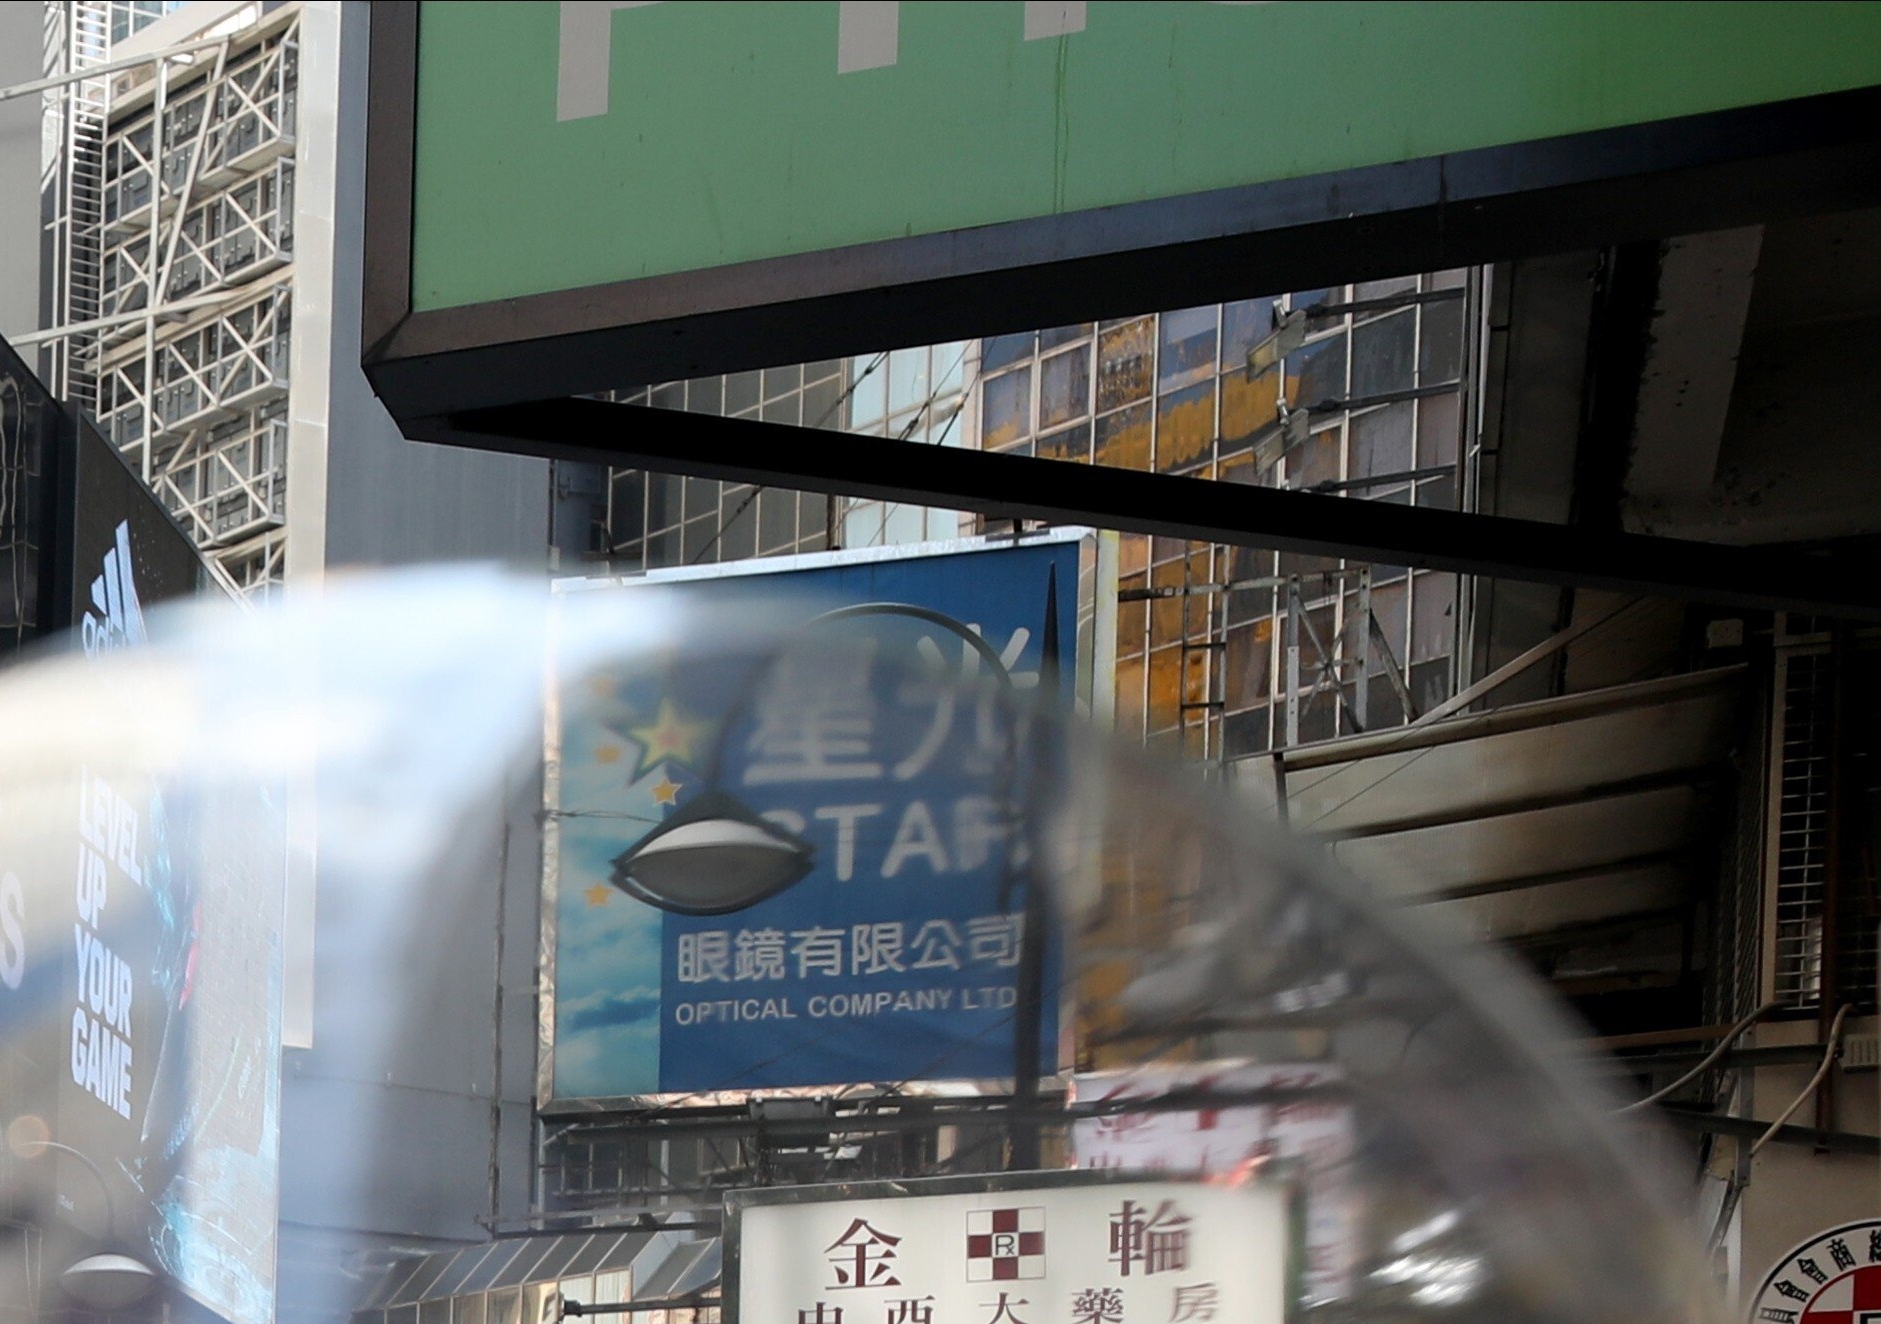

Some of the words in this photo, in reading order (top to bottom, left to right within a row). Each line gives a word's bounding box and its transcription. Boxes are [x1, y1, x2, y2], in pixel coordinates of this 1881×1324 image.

[79, 763, 143, 886] LEVEL
[76, 842, 108, 930] UP
[74, 922, 133, 1038] YOUR
[677, 912, 1025, 983] 眼鏡有限公司
[676, 995, 798, 1025] OPTICAL
[808, 988, 954, 1017] COMPANY
[71, 1006, 133, 1121] GAME
